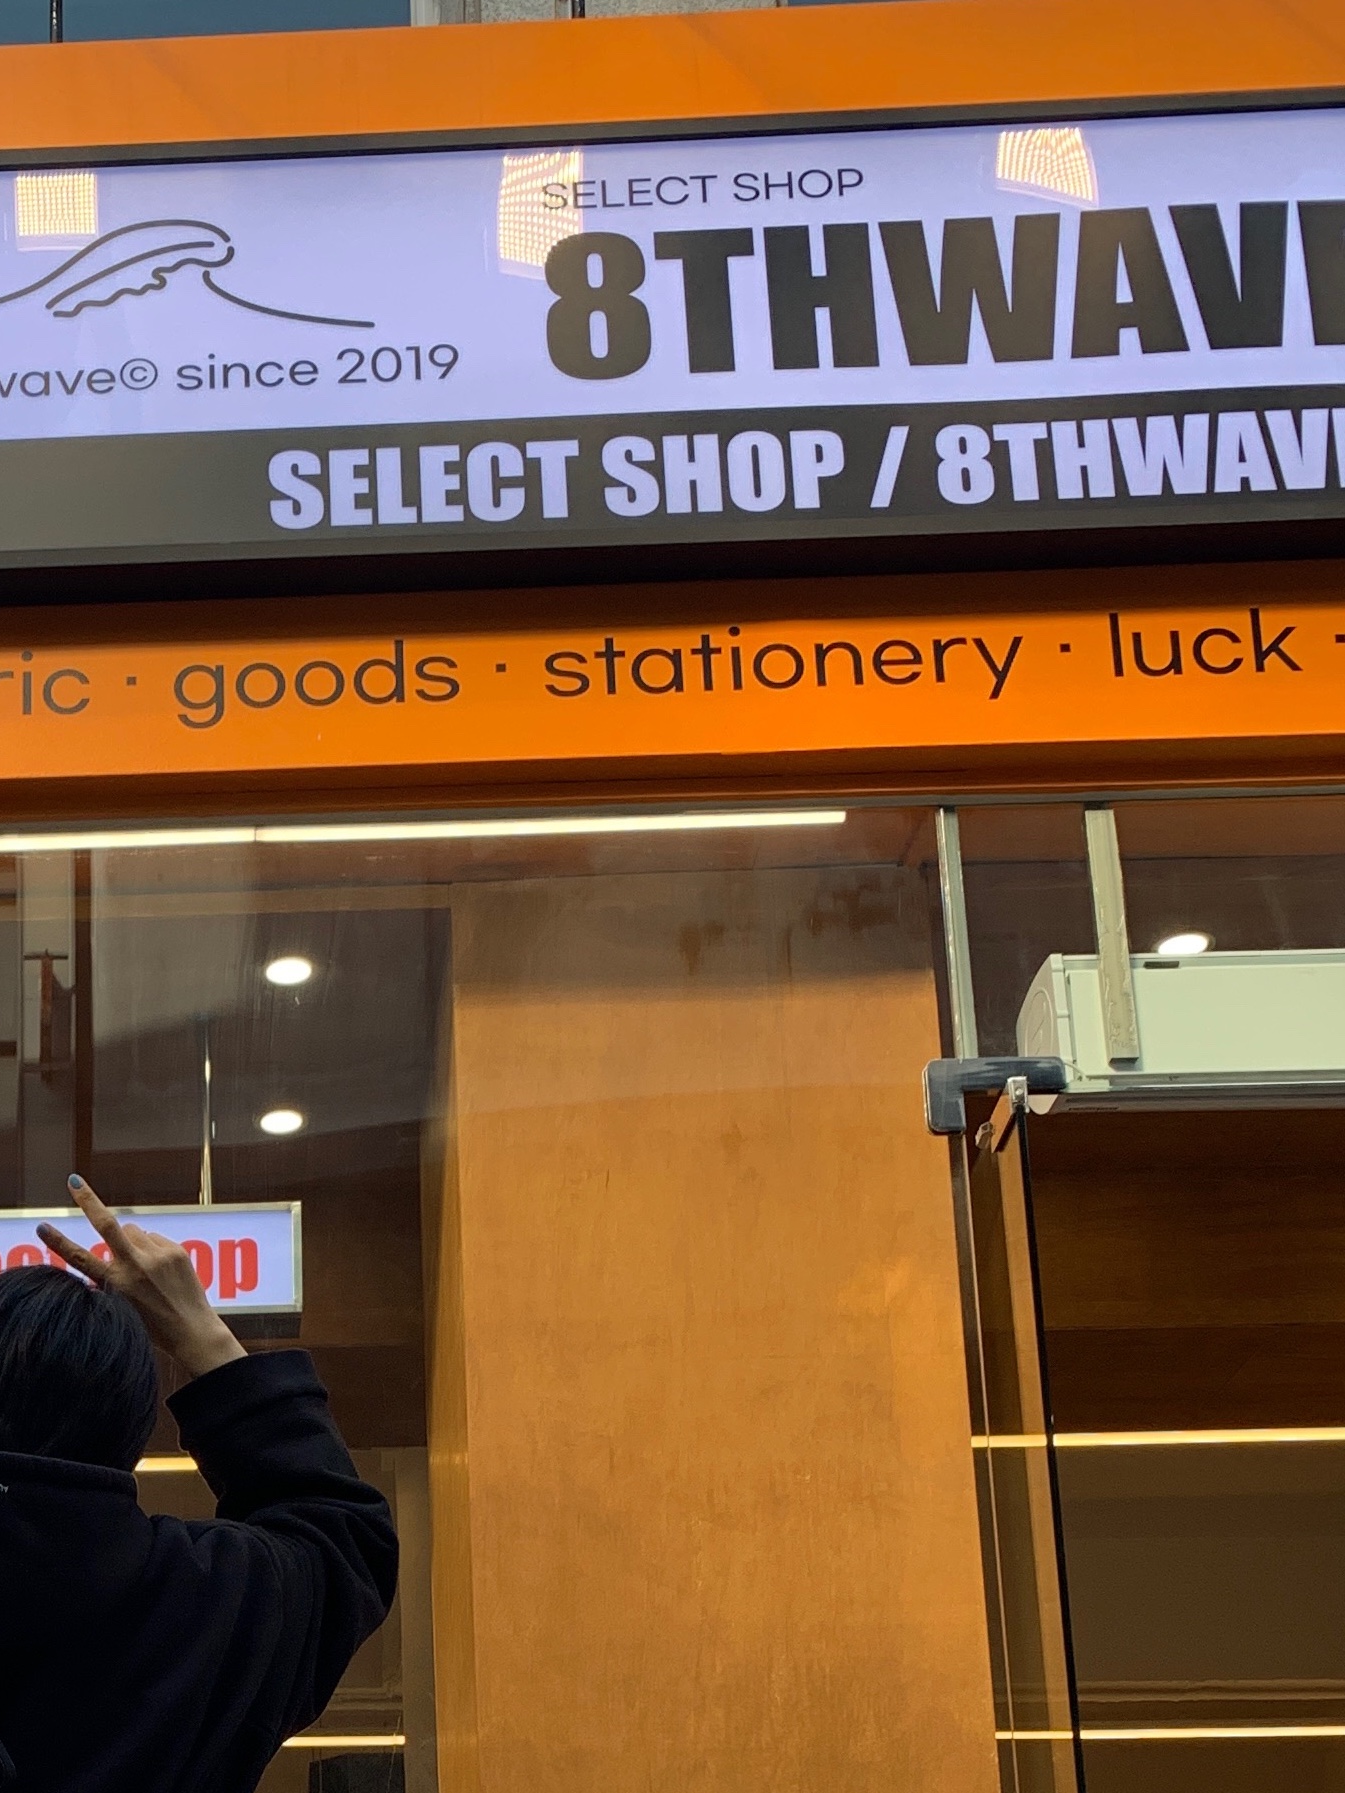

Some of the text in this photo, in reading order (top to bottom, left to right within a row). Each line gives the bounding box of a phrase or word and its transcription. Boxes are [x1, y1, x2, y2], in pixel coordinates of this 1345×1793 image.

[541, 167, 864, 211] SELECT SHOP
[176, 353, 319, 391] since
[337, 344, 459, 385] 2019
[267, 437, 579, 530] SELECT
[602, 429, 845, 518] SHOP
[935, 408, 1345, 505] 8THWAV
[173, 641, 460, 730] goods
[544, 626, 1022, 700] stationery
[1110, 608, 1302, 678] luck
